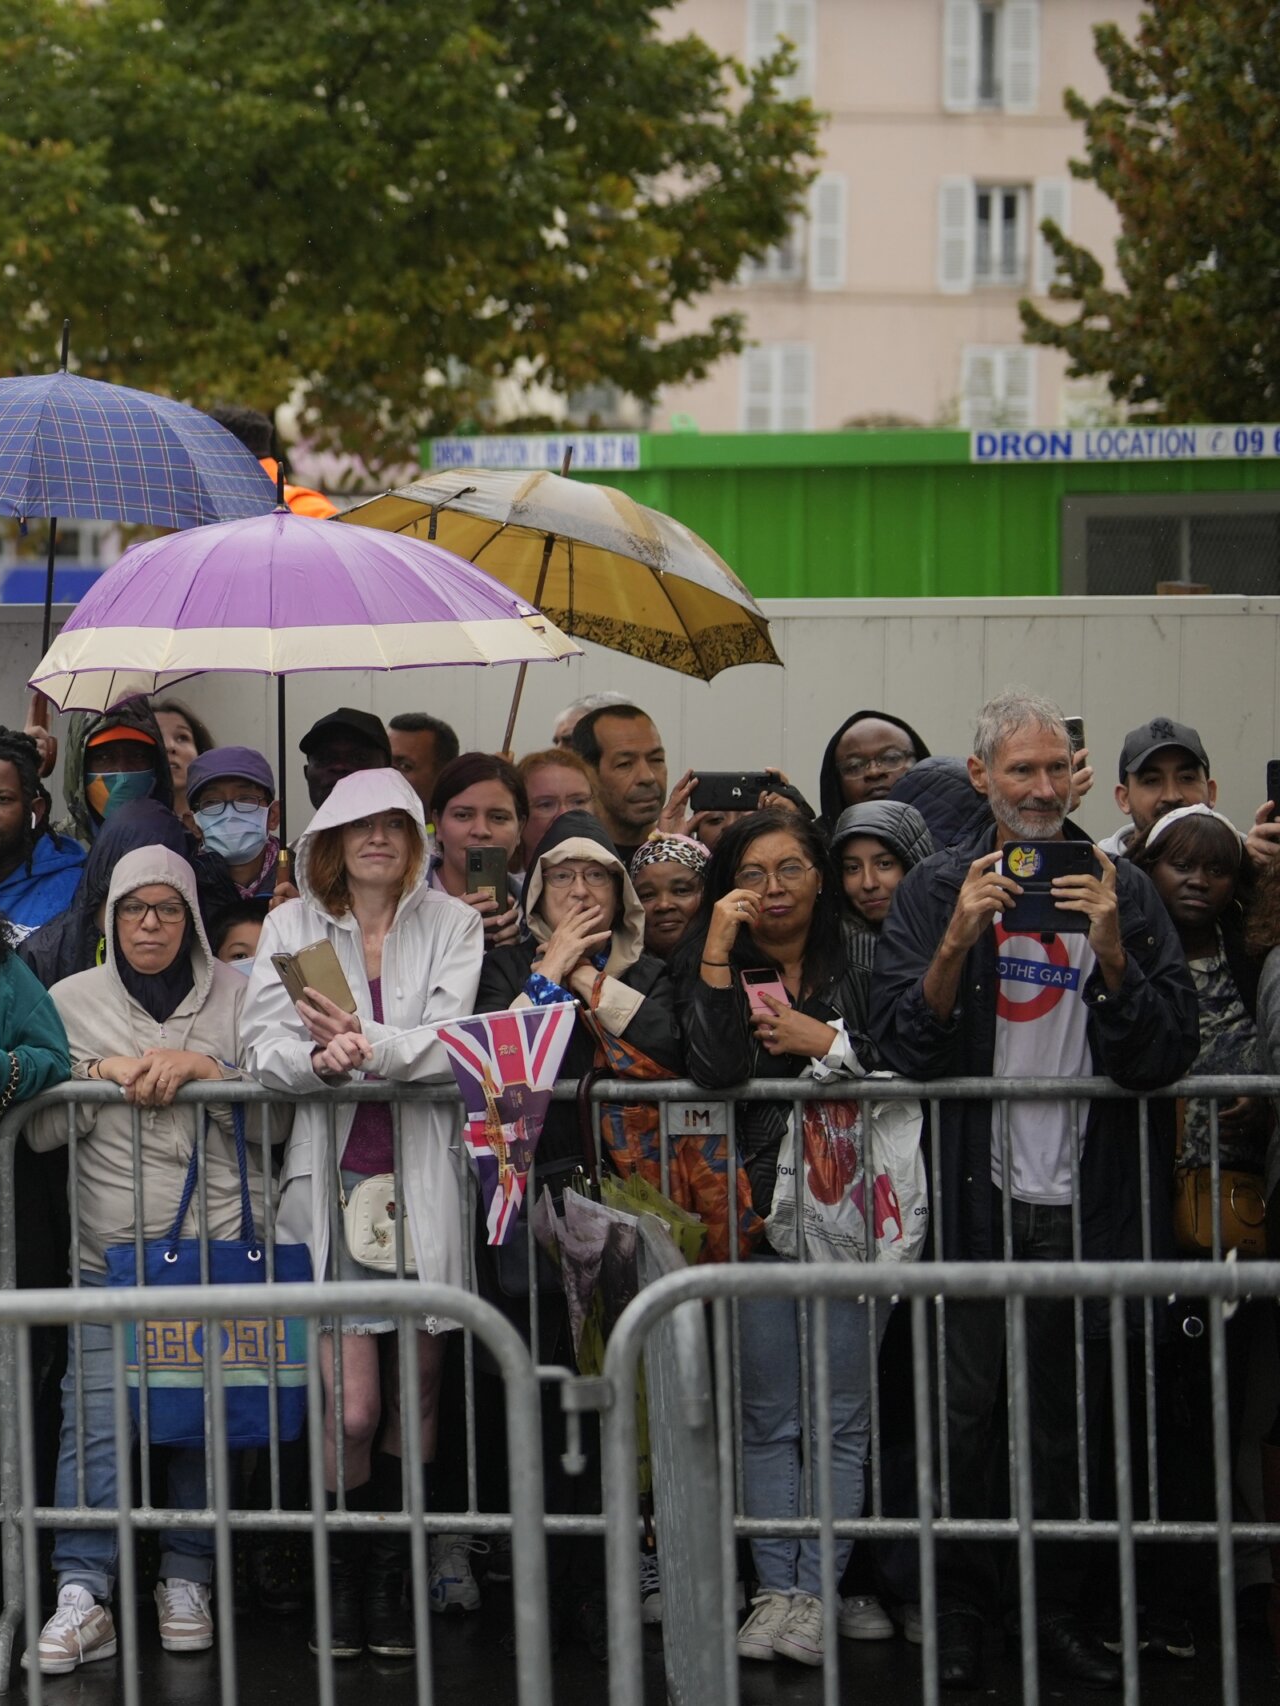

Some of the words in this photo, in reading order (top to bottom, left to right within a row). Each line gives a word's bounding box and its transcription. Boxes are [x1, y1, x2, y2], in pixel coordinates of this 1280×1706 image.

[976, 431, 1072, 458] DRON
[1084, 429, 1196, 457] LOCATION
[1235, 428, 1264, 456] 09
[1009, 963, 1036, 979] THE
[1039, 968, 1073, 985] GAP
[776, 1164, 797, 1176] fou
[914, 1207, 930, 1216] ca
